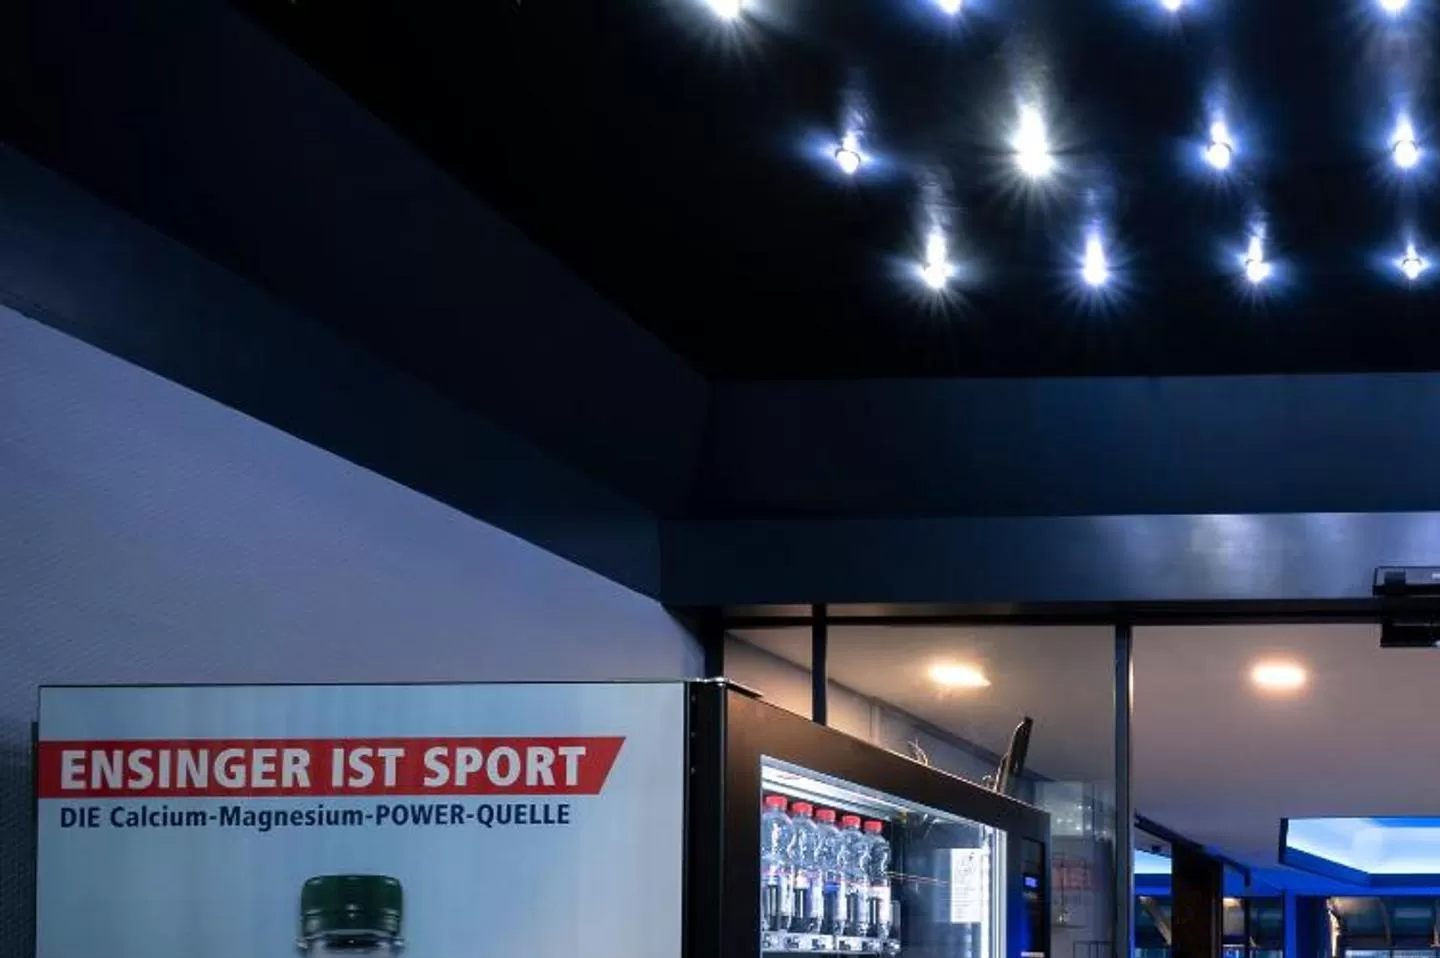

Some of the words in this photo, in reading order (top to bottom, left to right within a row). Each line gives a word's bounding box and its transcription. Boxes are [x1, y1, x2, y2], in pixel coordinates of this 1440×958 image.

[61, 748, 311, 789] ENSINGER
[331, 747, 405, 788] IST
[423, 746, 586, 787] SPORT
[61, 806, 101, 828] DIE
[110, 803, 570, 832] Calcium-Magnesium-POWER-QUELLE
